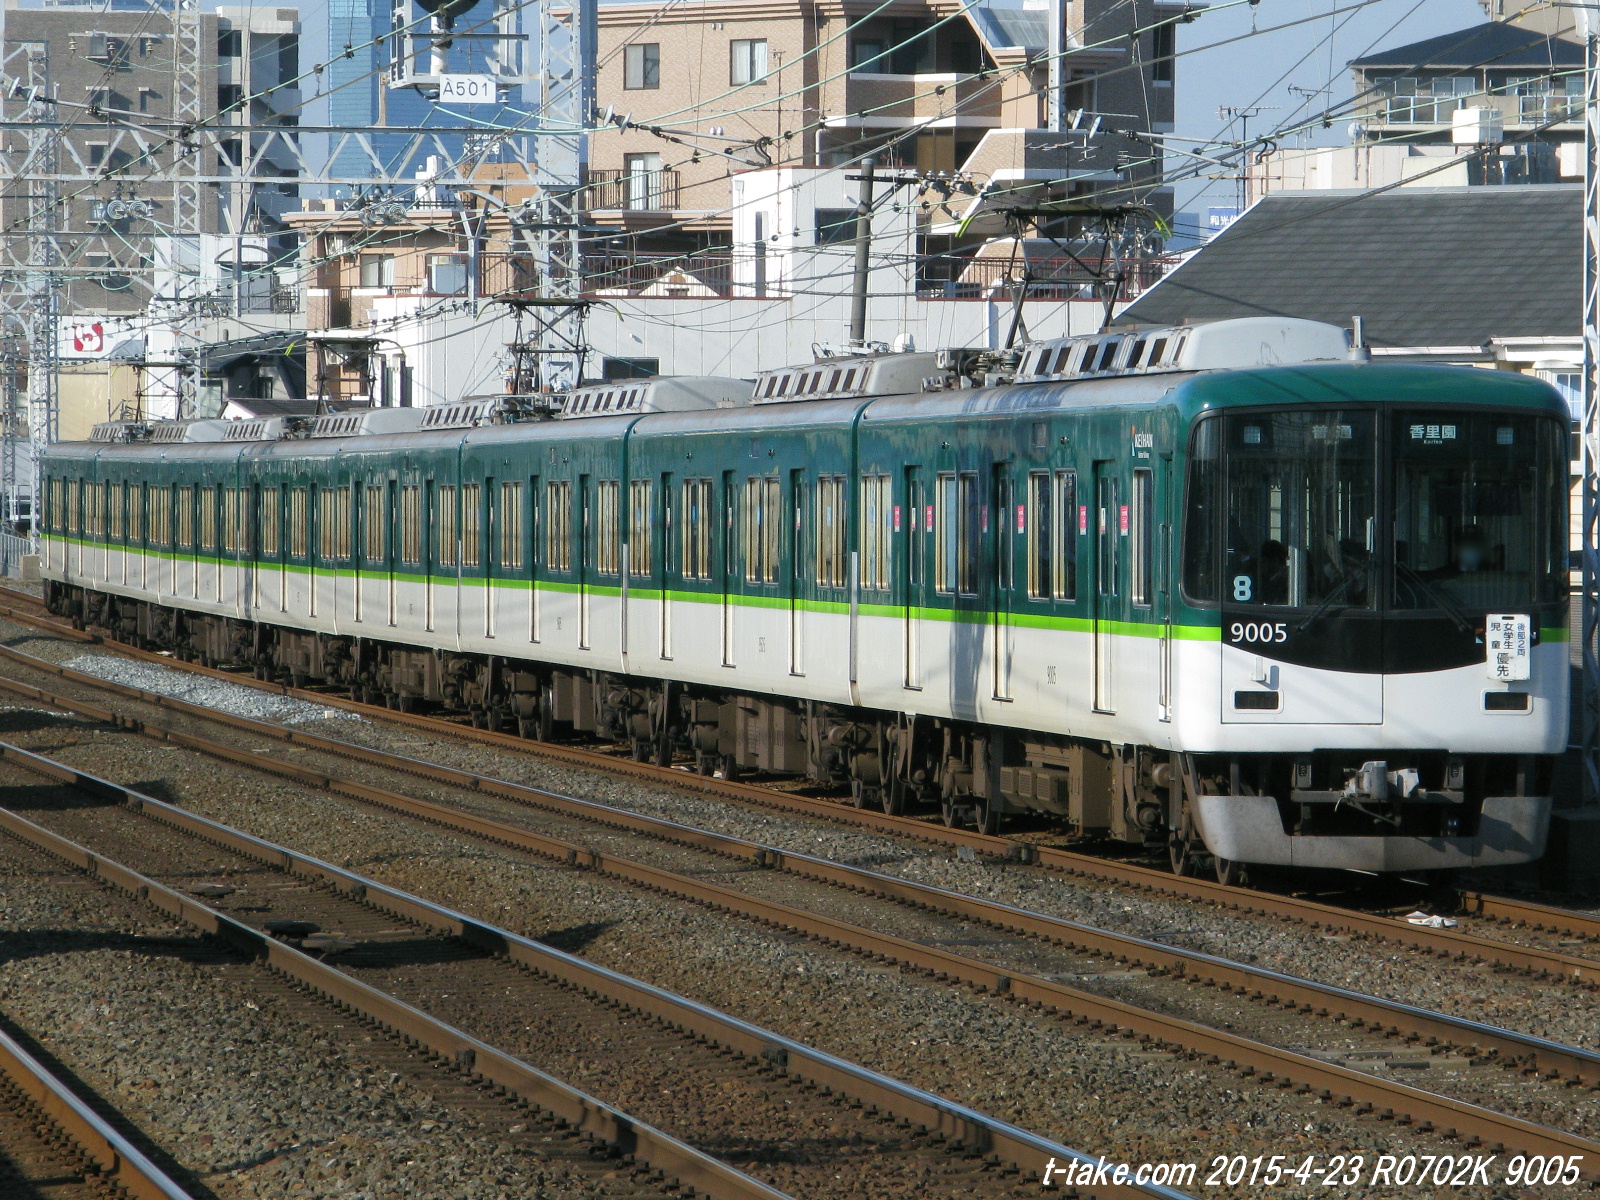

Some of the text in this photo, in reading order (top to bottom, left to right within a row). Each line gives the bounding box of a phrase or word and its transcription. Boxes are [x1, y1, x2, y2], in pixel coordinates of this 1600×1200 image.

[443, 81, 488, 96] A501
[1410, 424, 1456, 439] 香里園
[1233, 575, 1252, 601] 8
[1230, 622, 1288, 643] 9005
[1503, 622, 1514, 650] 女学生
